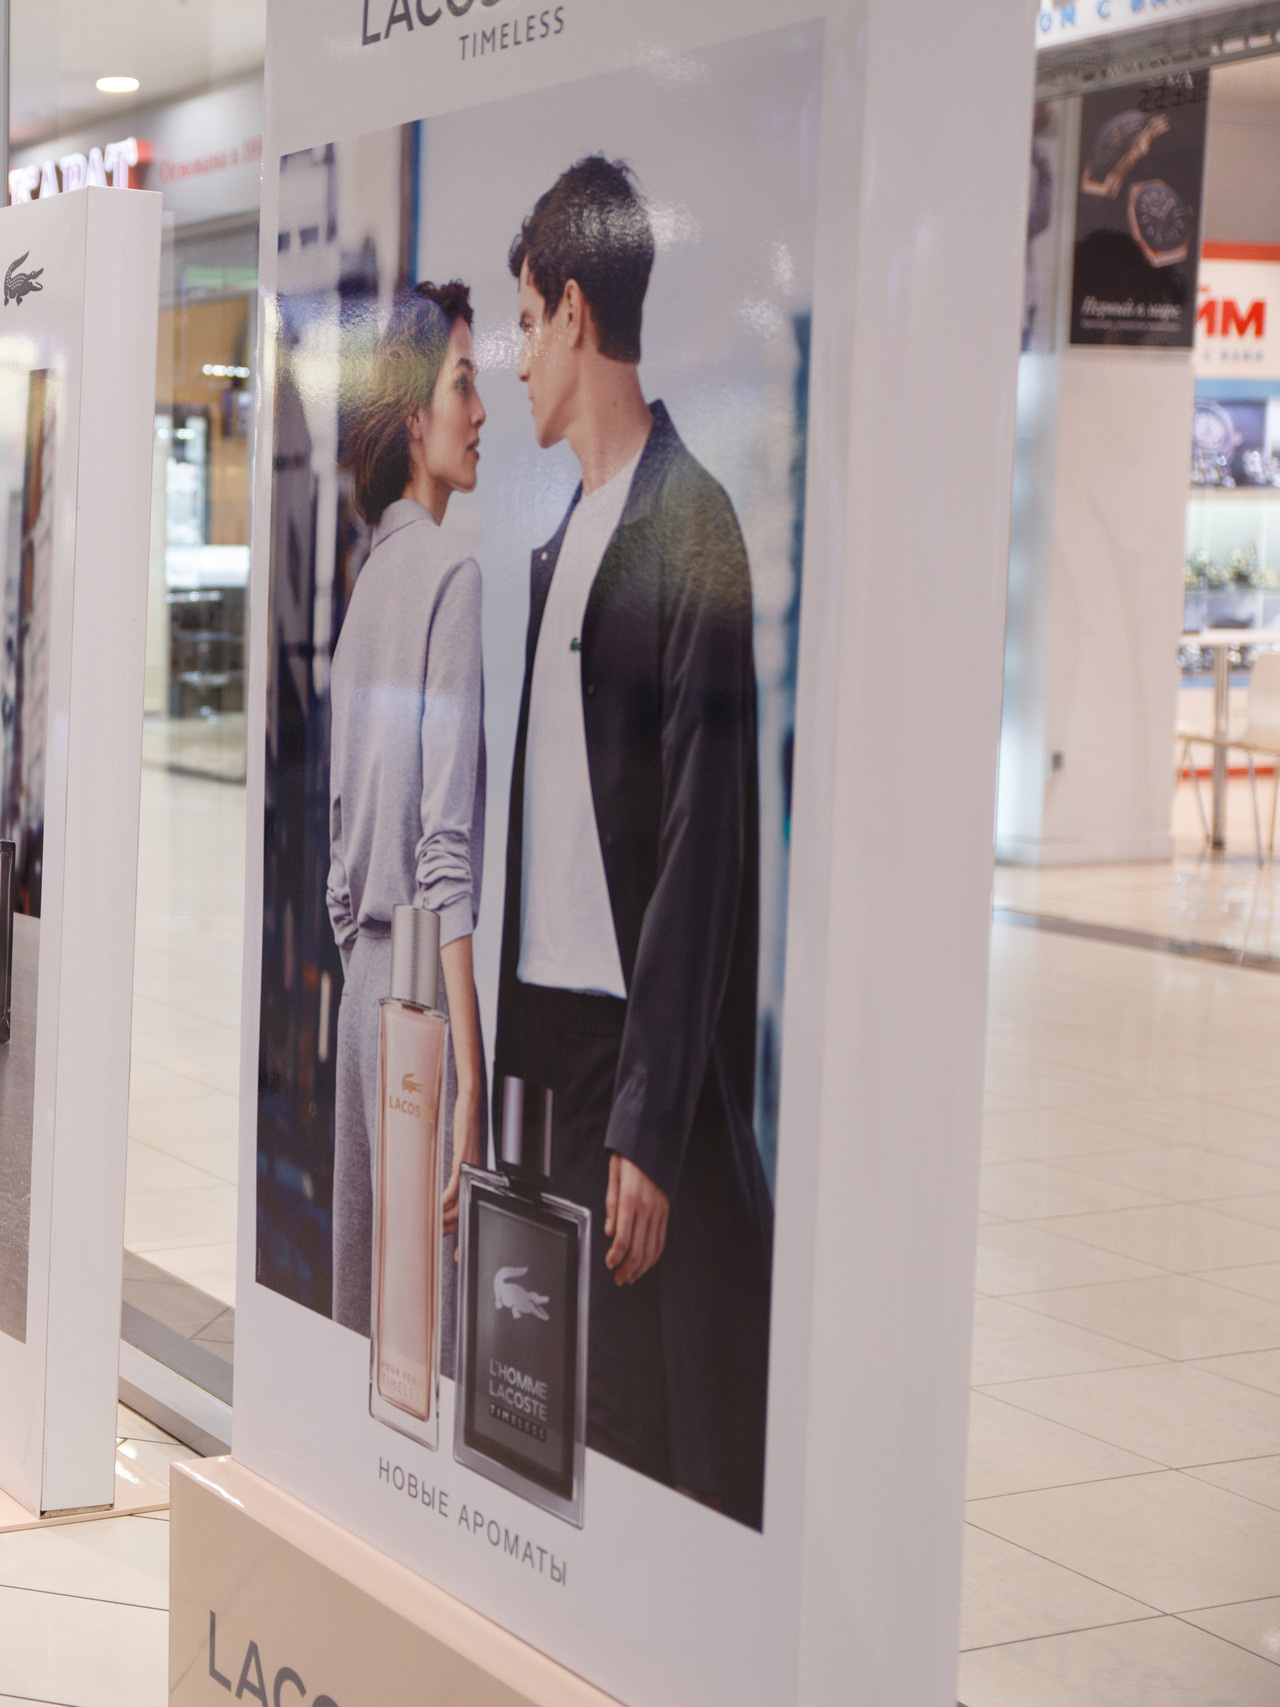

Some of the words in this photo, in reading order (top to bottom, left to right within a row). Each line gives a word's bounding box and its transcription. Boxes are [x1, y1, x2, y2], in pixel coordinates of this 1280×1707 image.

[459, 6, 565, 61] TIMELESS
[489, 1358, 548, 1400] L'HOMME
[489, 1379, 548, 1422] LACOSTE
[489, 1403, 547, 1440] TIMELESS
[378, 1455, 449, 1518] НОВЫЕ
[458, 1503, 567, 1587] АРОМАТЫ
[209, 1609, 340, 1707] LAC
